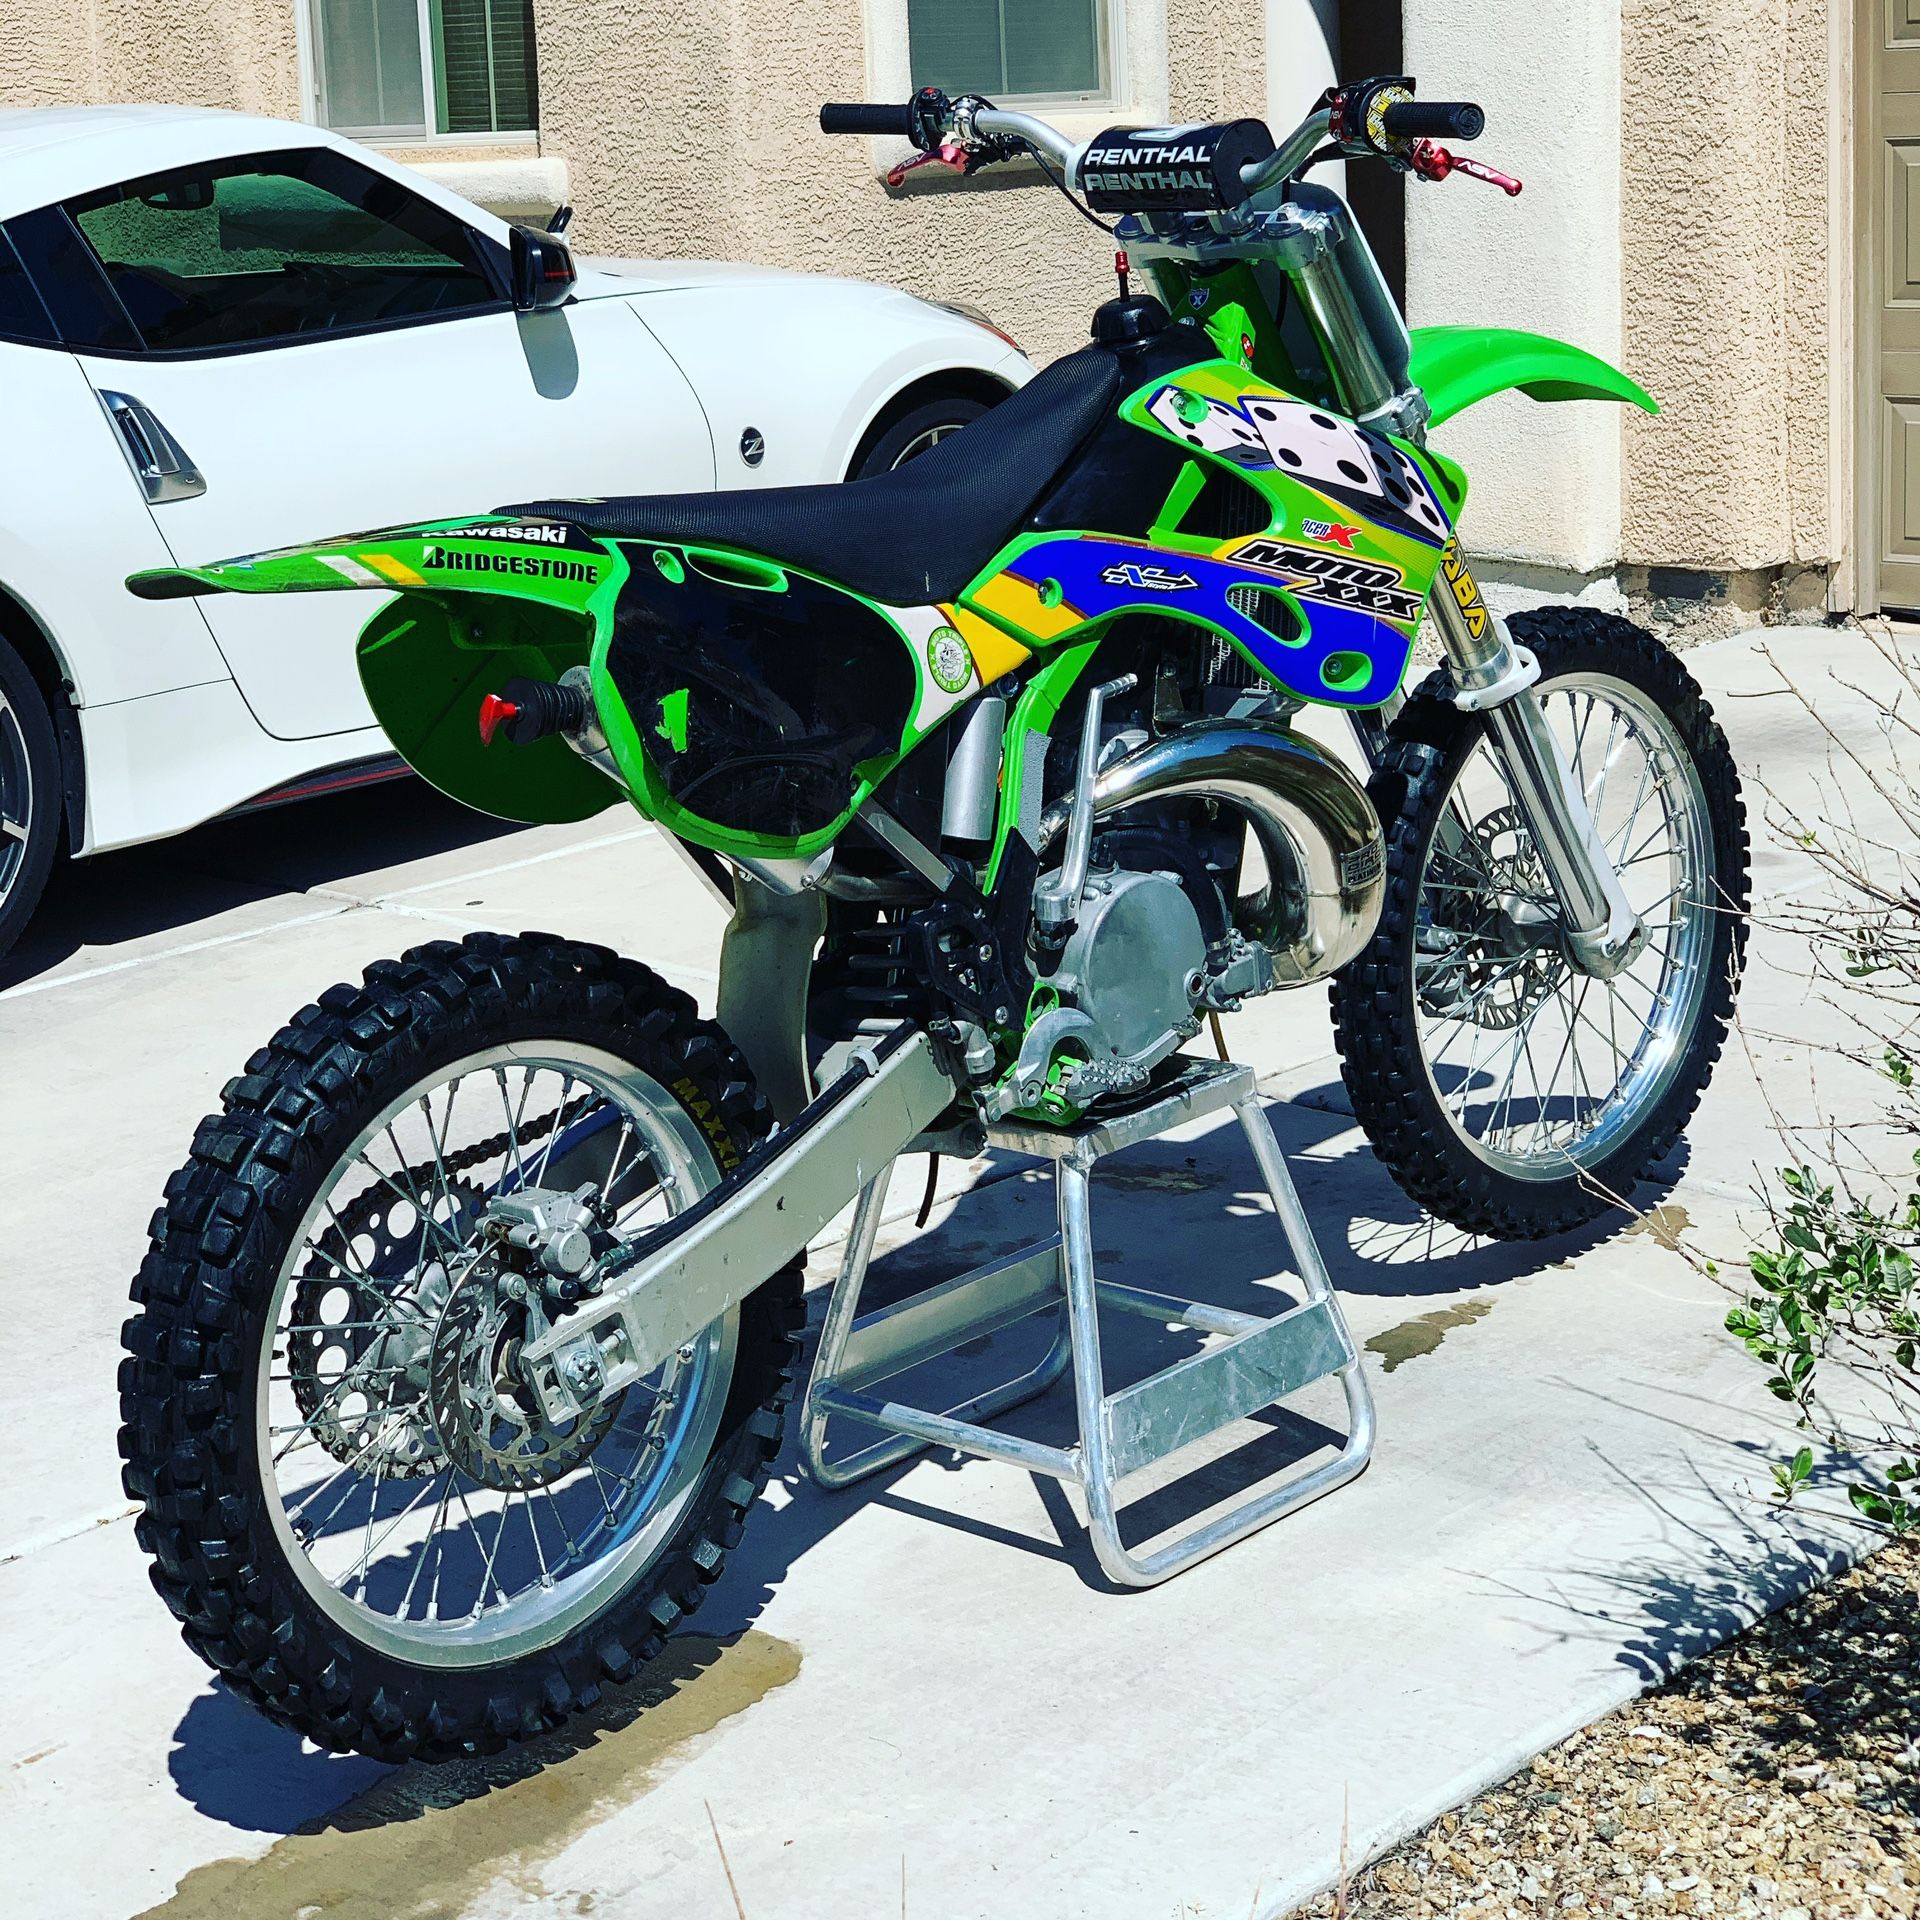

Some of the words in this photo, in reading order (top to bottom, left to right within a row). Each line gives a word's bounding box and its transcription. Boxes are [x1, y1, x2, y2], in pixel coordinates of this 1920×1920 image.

[1084, 145, 1211, 166] RENTHAL
[1083, 170, 1213, 191] RENTHAL
[1457, 161, 1501, 179] ASV
[744, 437, 765, 456] Z
[422, 545, 598, 585] BRIDGESTONE
[1237, 543, 1399, 589] MOTO
[1300, 576, 1424, 620] XXX
